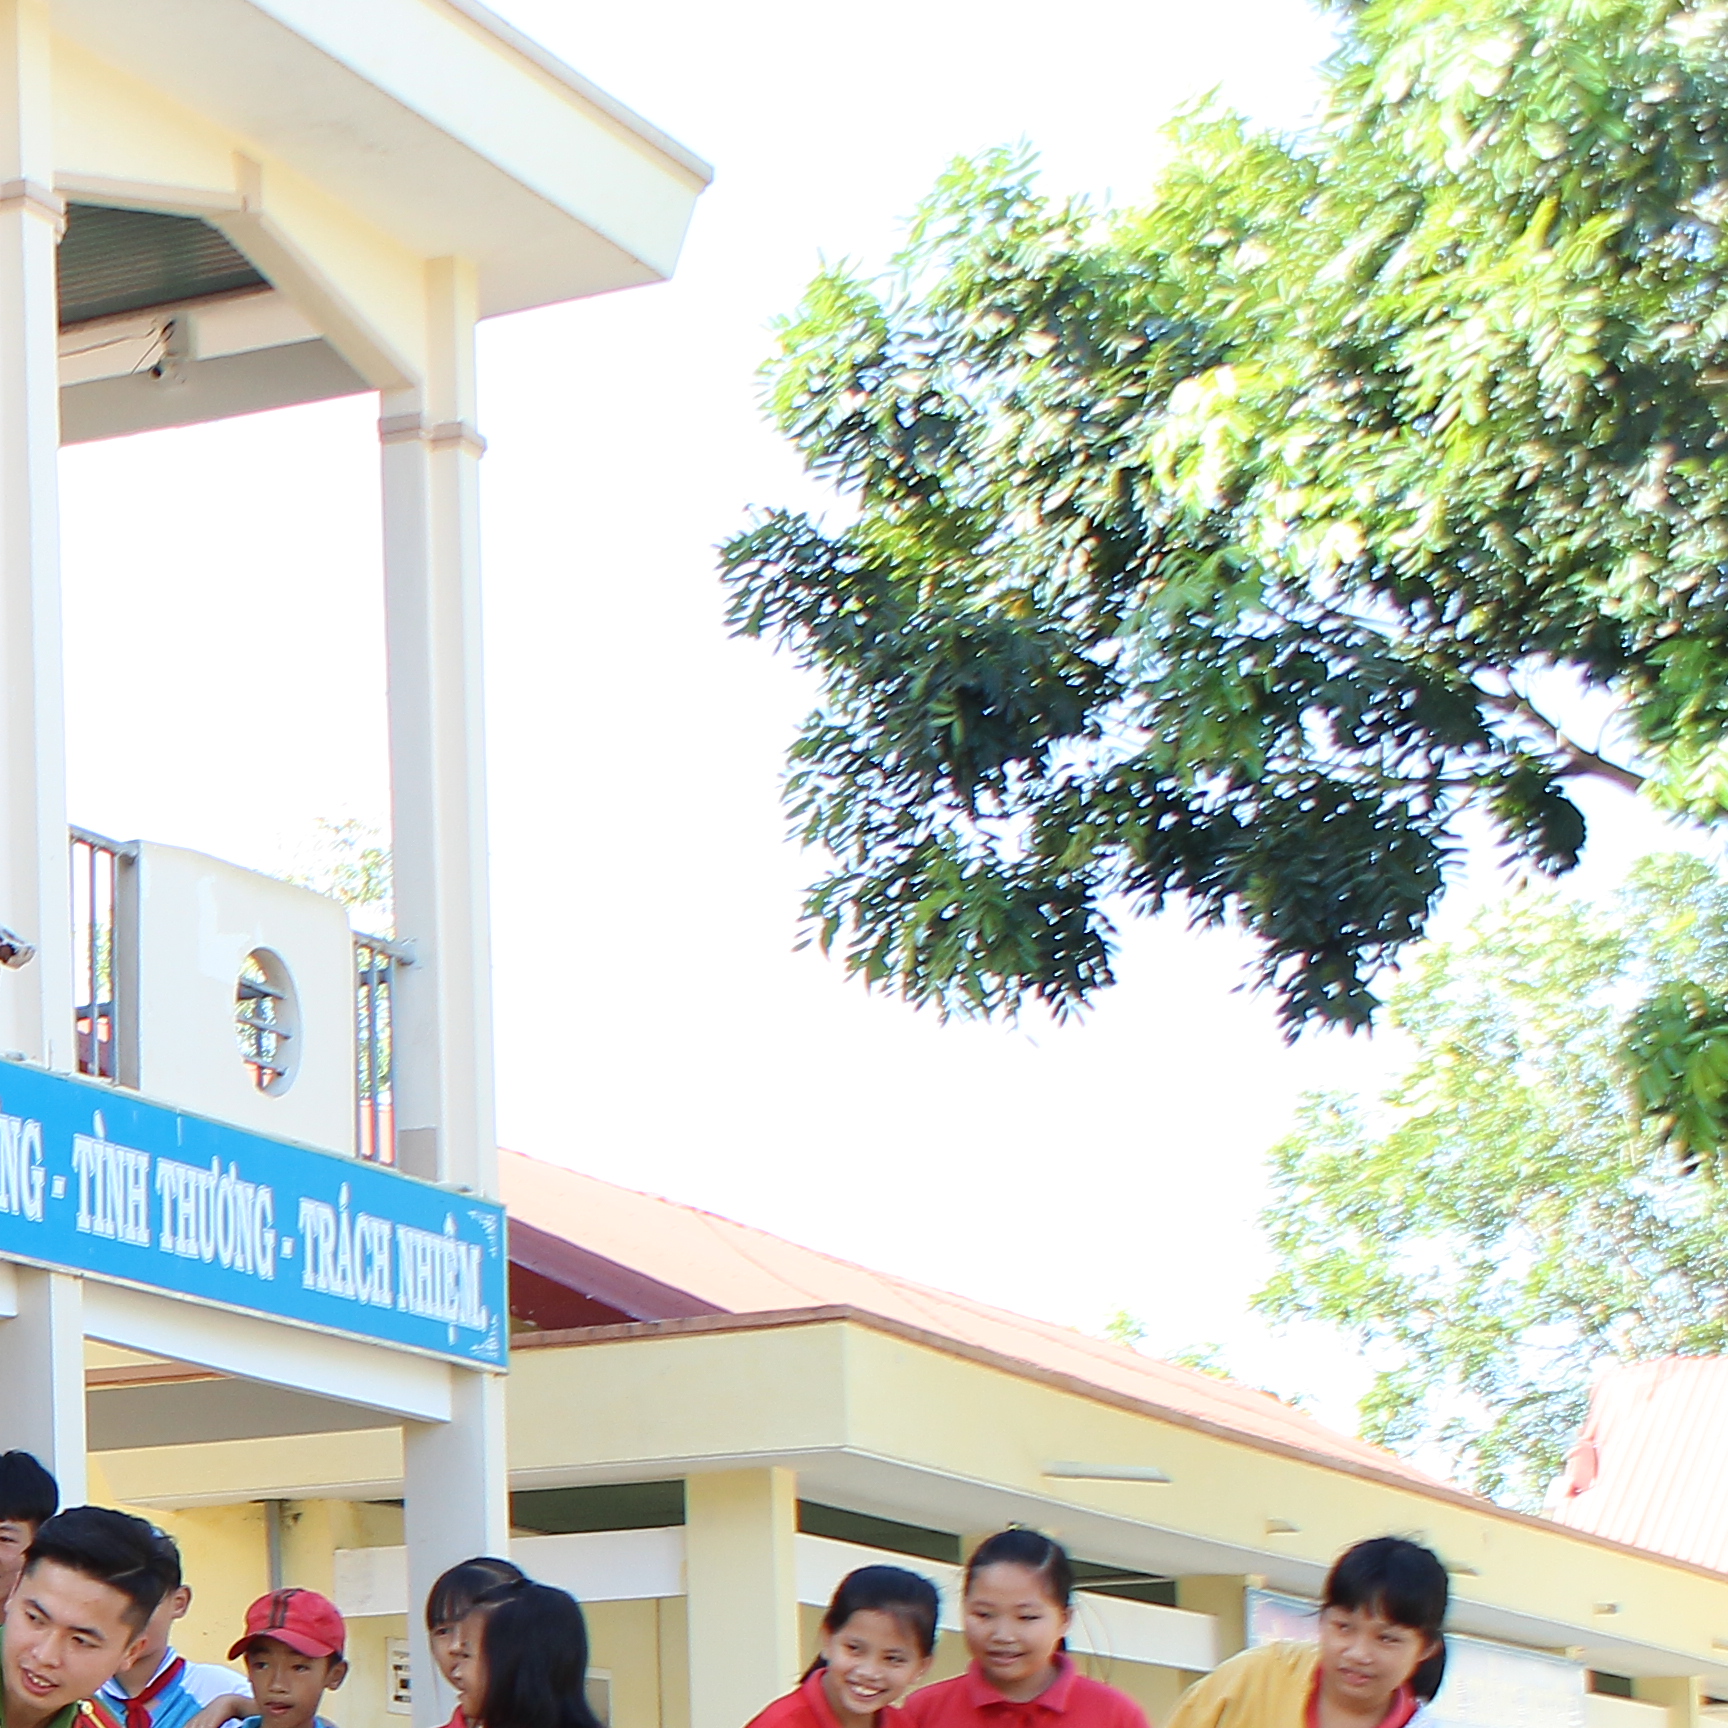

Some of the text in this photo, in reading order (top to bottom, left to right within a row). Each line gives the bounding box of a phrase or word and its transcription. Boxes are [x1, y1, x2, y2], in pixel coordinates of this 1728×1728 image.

[72, 1109, 151, 1248] TÌNH
[155, 1155, 276, 1281] THƯƠNG
[297, 1182, 394, 1310] TRÁCH
